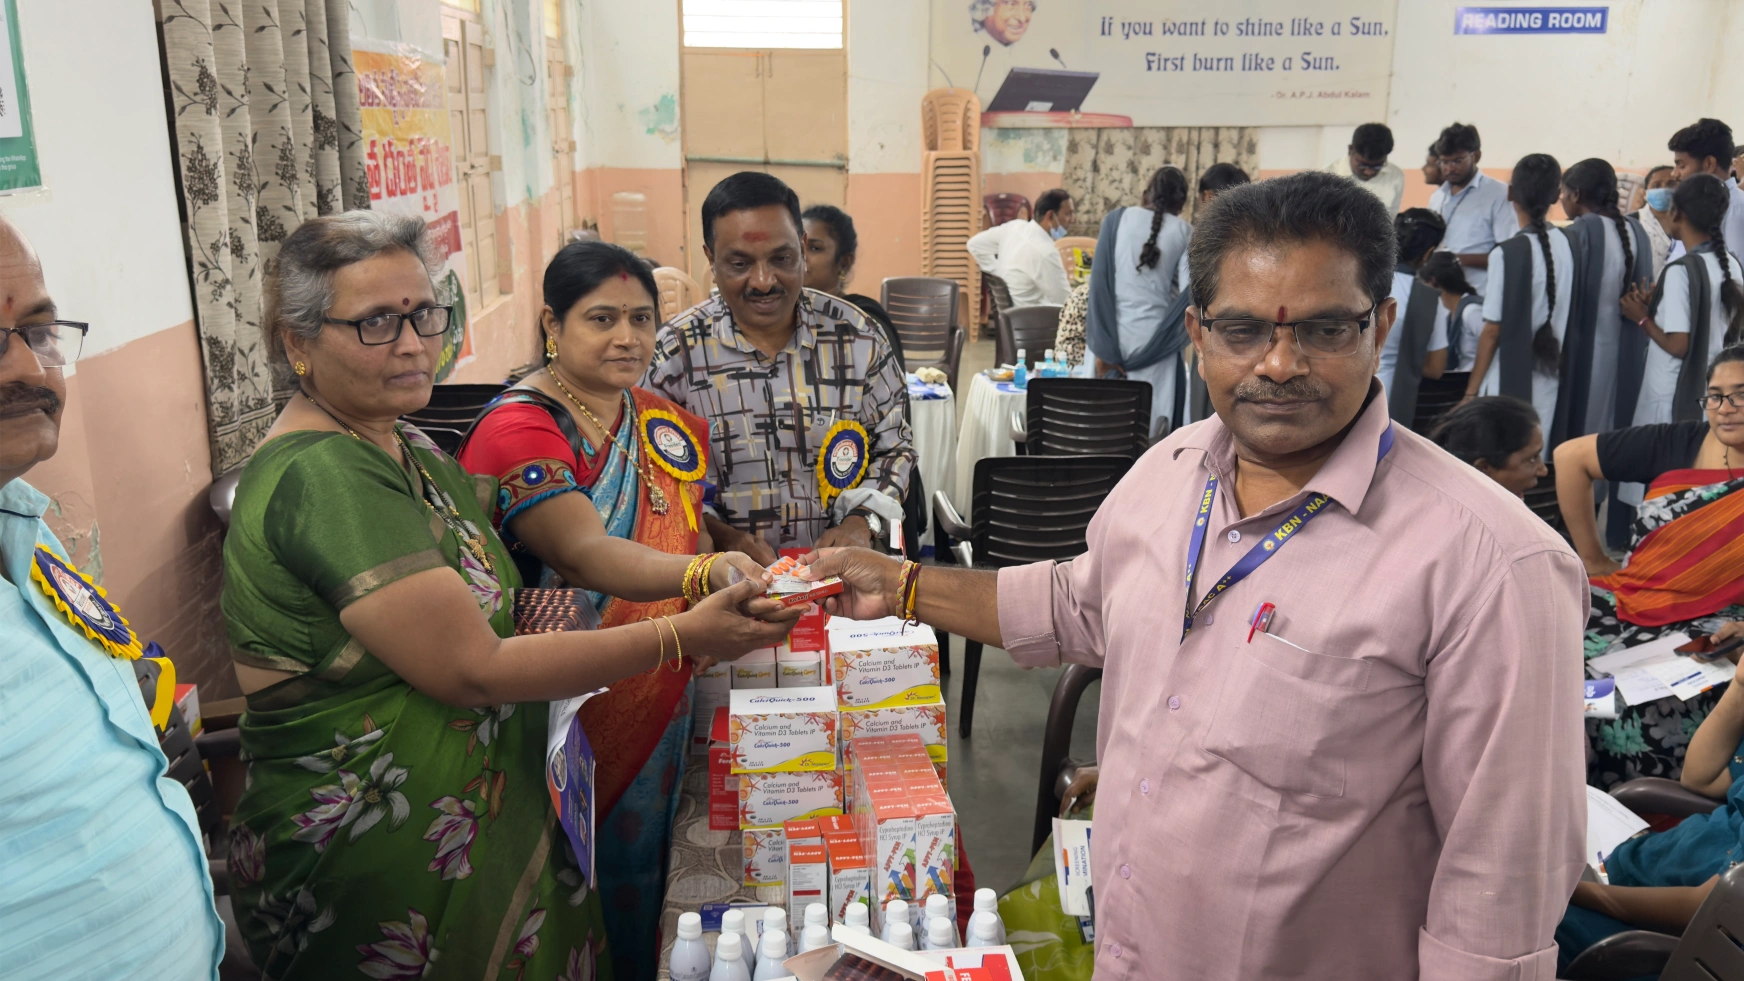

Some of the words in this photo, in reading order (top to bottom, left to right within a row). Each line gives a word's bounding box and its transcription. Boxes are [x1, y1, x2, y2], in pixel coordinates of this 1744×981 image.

[1100, 17, 1114, 36] If
[1121, 19, 1153, 40] you
[1162, 19, 1206, 36] want
[1213, 18, 1229, 36] to
[1236, 17, 1283, 36] shine
[1291, 17, 1323, 36] like
[1331, 21, 1342, 36] a
[1462, 12, 1542, 29] READING
[1548, 12, 1602, 28] ROOM
[1145, 52, 1185, 71] First
[1193, 53, 1234, 71] burn
[1241, 52, 1274, 71] like
[1282, 56, 1292, 71] a
[1300, 52, 1340, 71] Sun.
[1344, 91, 1370, 99] Kalam
[1200, 489, 1213, 513] KBN
[1274, 515, 1302, 541] KBN
